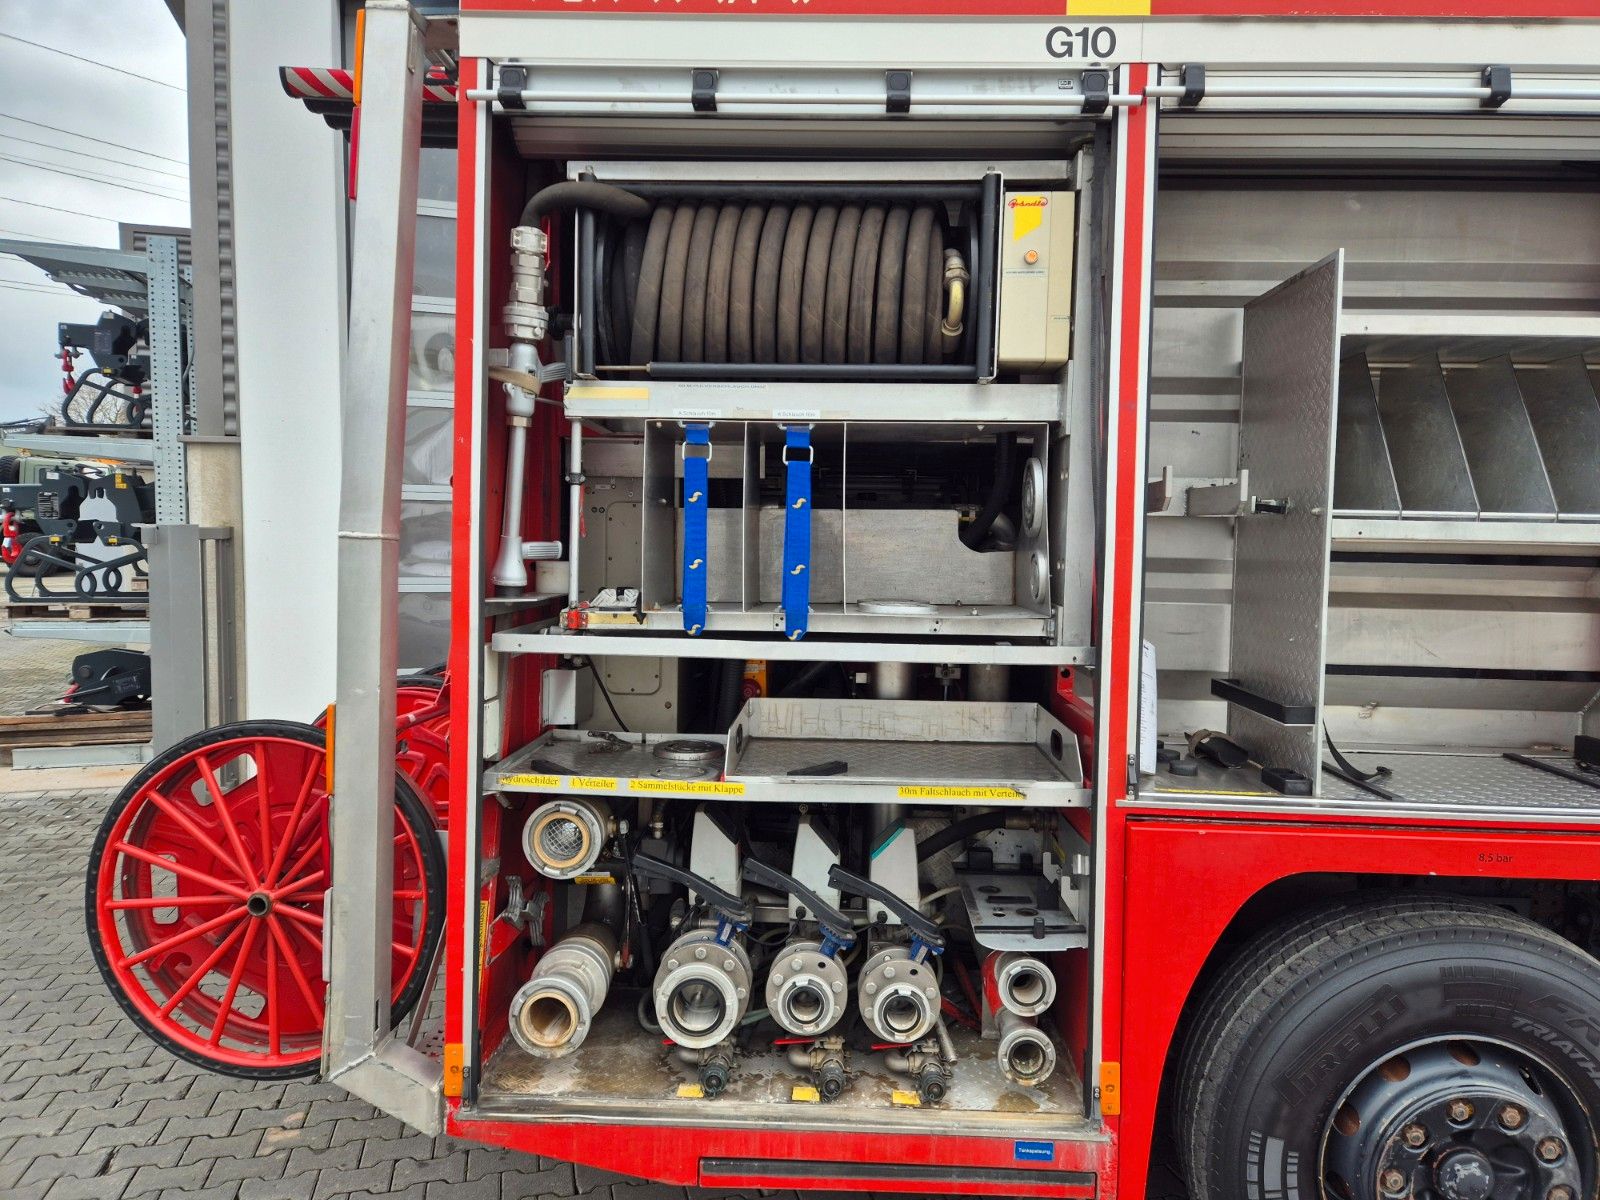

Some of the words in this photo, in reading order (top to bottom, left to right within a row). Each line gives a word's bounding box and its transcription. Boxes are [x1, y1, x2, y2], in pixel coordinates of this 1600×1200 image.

[1046, 26, 1116, 58] G10
[578, 778, 615, 788] Verteiler
[698, 783, 711, 792] mit
[714, 784, 743, 795] Klappe
[900, 786, 917, 795] 30m
[920, 787, 971, 797] Faltschlauch
[973, 788, 987, 797] mit
[1497, 853, 1513, 863] bar
[1272, 982, 1408, 1109] PIRELLI
